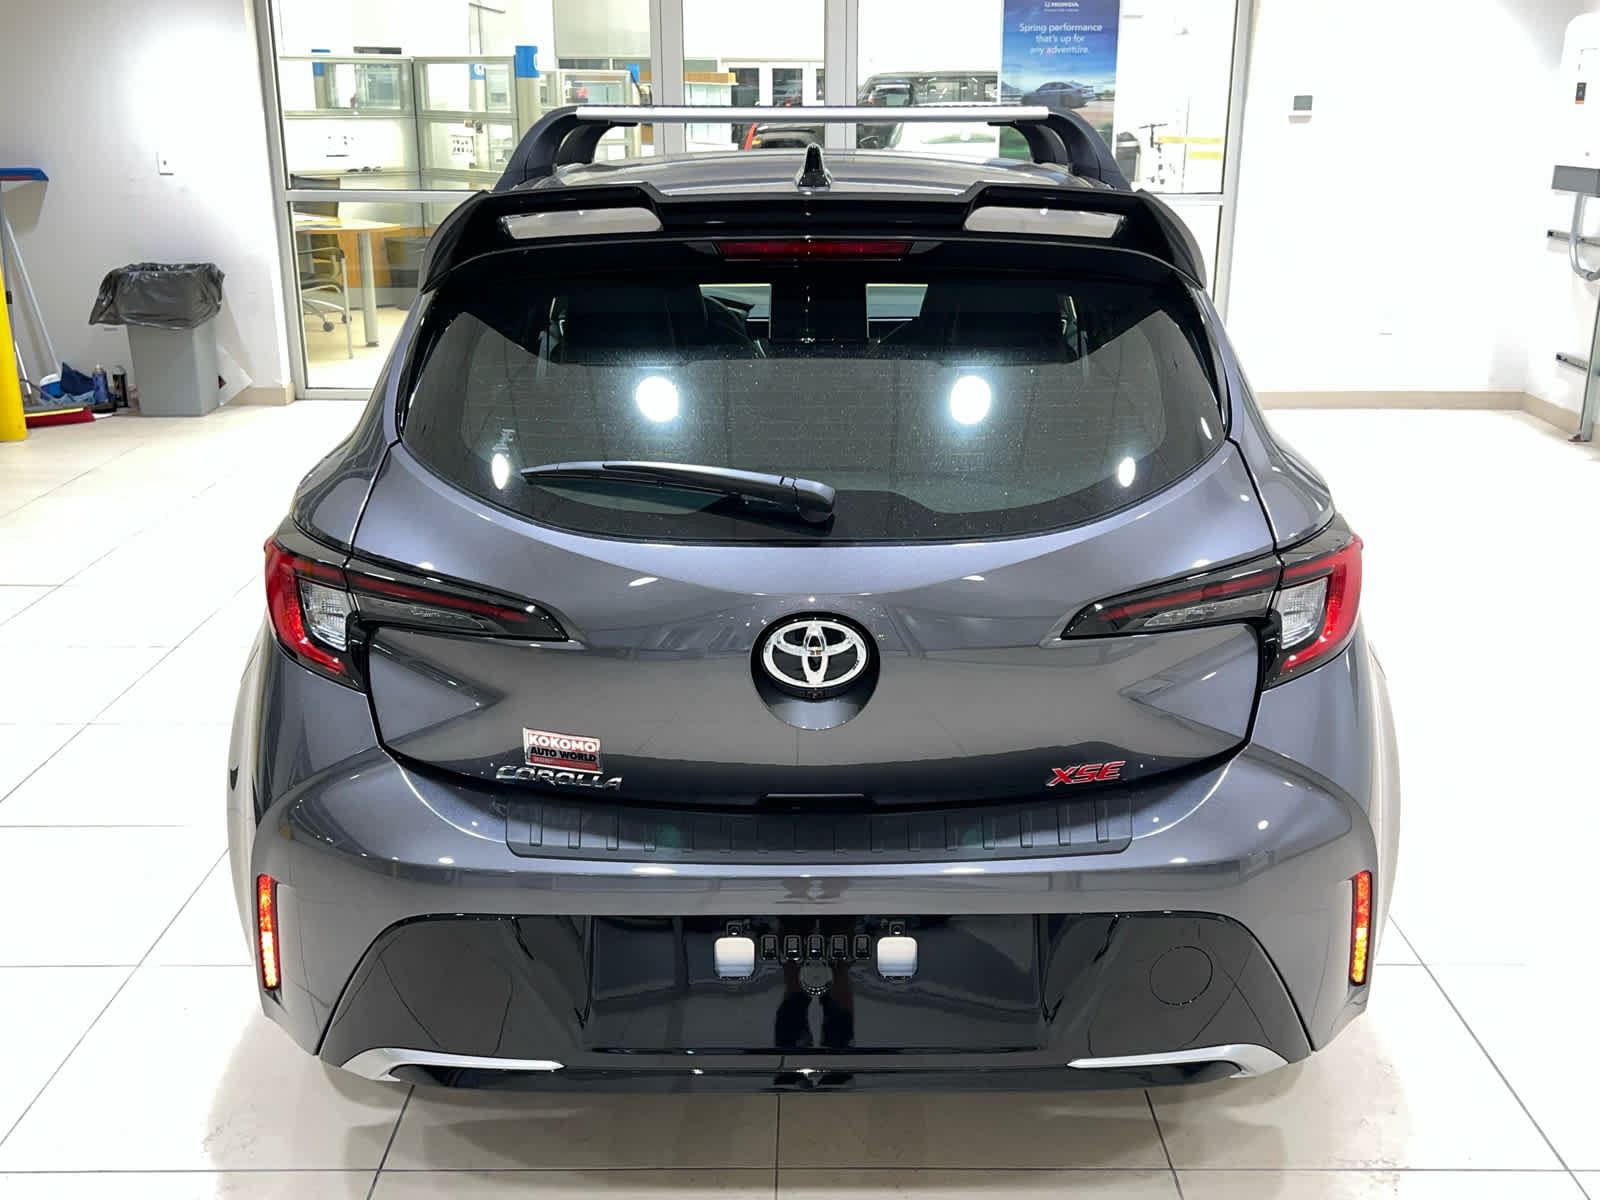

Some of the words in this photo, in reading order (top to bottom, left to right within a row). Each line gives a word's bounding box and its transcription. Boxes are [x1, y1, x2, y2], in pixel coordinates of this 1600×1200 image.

[1019, 23, 1047, 33] Spring
[1049, 23, 1103, 33] performance
[1036, 34, 1058, 42] that's
[1060, 36, 1071, 44] up
[1073, 34, 1085, 42] for
[1030, 47, 1044, 56] any
[528, 734, 597, 753] KOKOMO
[530, 746, 557, 757] AUTO
[559, 750, 596, 762] WORLD
[496, 765, 624, 790] COROLLA
[1045, 761, 1126, 786] XSE
